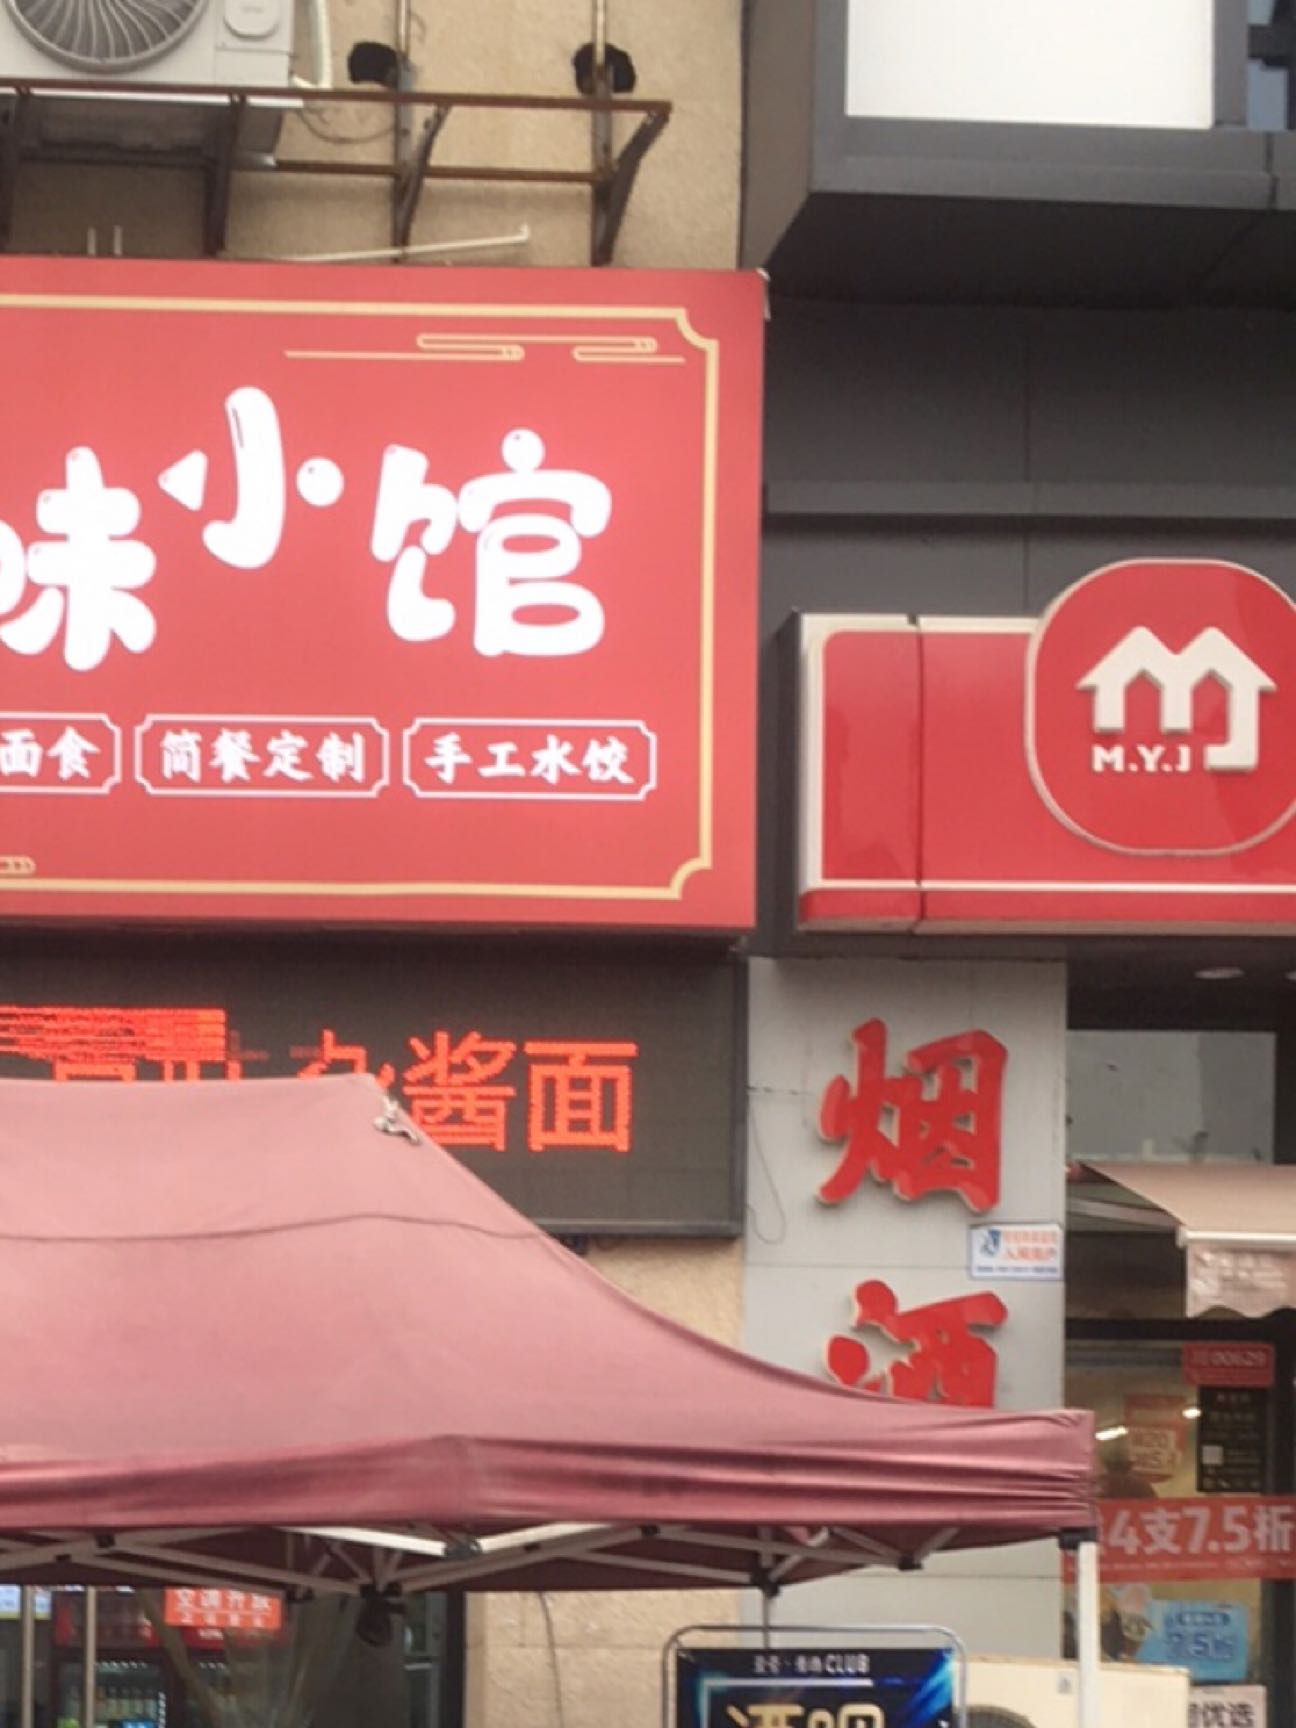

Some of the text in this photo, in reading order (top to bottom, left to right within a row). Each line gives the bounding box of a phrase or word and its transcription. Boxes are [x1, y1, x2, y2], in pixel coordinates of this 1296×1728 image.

[160, 729, 365, 784] 简餐定制
[425, 732, 635, 785] 手工水饺
[294, 1028, 639, 1153] 酱面
[1098, 1504, 1294, 1556] 4支7.5折
